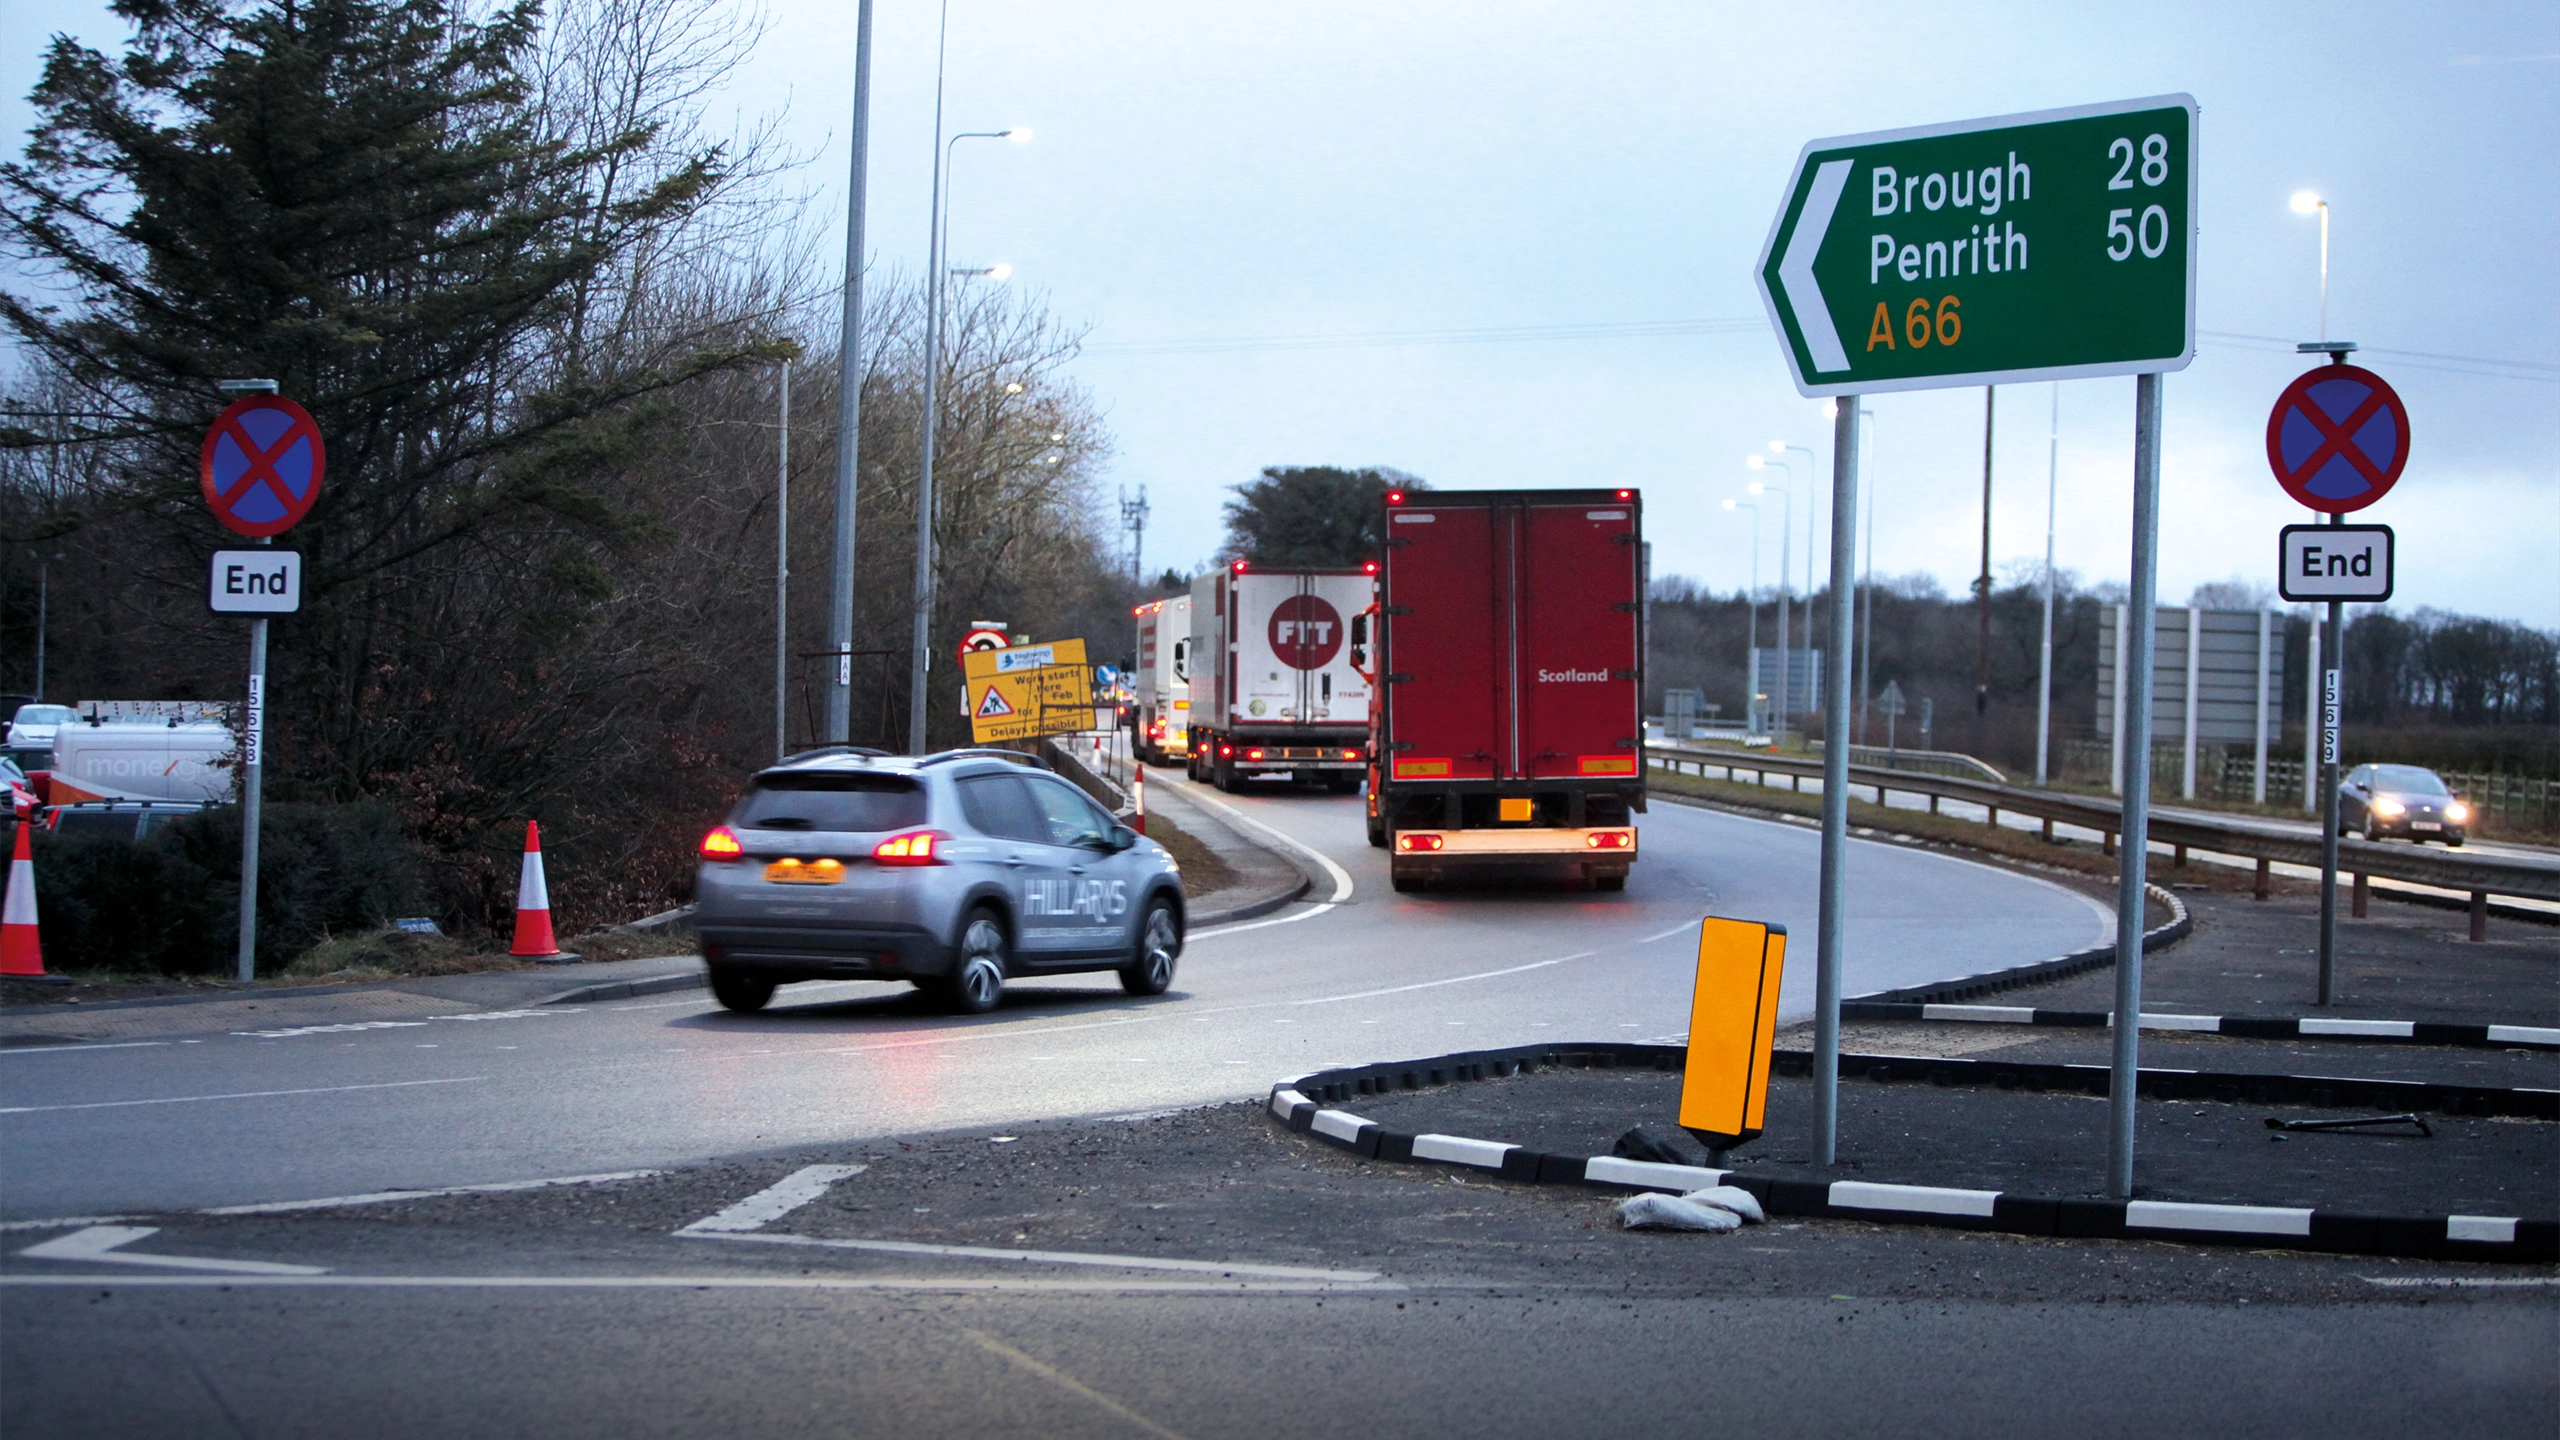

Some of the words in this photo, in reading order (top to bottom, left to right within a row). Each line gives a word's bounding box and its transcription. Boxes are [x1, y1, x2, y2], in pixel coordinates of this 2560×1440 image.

[1871, 151, 2031, 216] Brough
[2107, 133, 2169, 190] 28
[1870, 220, 2029, 285] Penrith
[2106, 204, 2170, 262] 50
[2302, 546, 2373, 578] End
[226, 565, 288, 595] End
[1538, 667, 1609, 683] Scotland
[1052, 690, 1073, 701] Feb
[1017, 707, 1034, 717] for
[990, 727, 1028, 738] Delays
